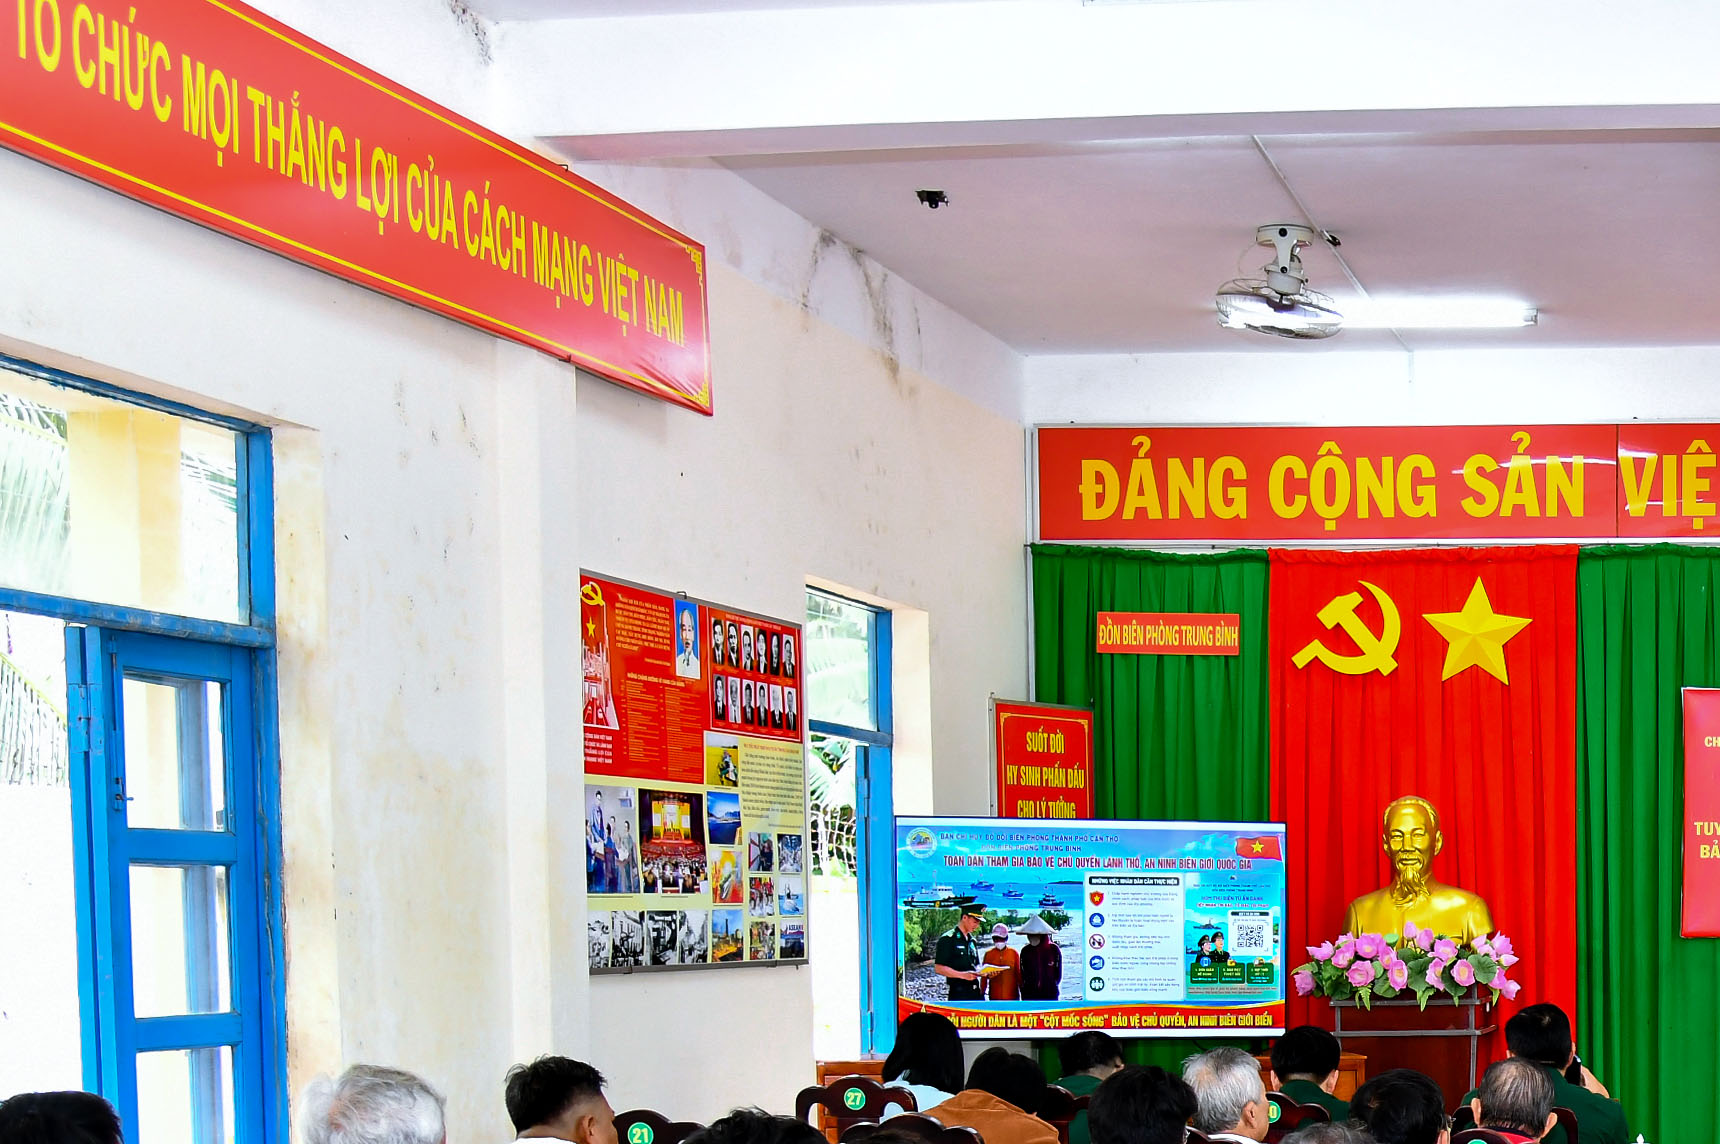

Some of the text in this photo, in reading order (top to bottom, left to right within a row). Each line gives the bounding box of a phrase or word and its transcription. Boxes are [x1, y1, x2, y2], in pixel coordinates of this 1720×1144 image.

[72, 3, 172, 122] CHỨC
[182, 54, 239, 167] MỌI
[247, 86, 347, 199] THẮNG
[355, 137, 399, 235] LỢI
[406, 155, 459, 249] CỦA
[463, 180, 527, 278] CÁCH
[532, 221, 593, 308] MẠNG
[597, 252, 639, 336] VIỆT
[644, 275, 685, 347] NAM
[1079, 435, 1248, 521] ĐẢNG
[1268, 441, 1439, 530] CỘNG
[1461, 431, 1584, 518] SẢN
[1099, 616, 1238, 647] ĐỒN BIÊN PHÒNG TRUNG BÌNH
[1027, 726, 1065, 754] SUỐT ĐỜI
[1007, 762, 1084, 788] HY SINH PHẤN ĐẤU
[1018, 800, 1034, 817] CHO
[1037, 798, 1046, 818] LÝ
[847, 1092, 861, 1106] 27
[633, 1128, 649, 1144] 21
